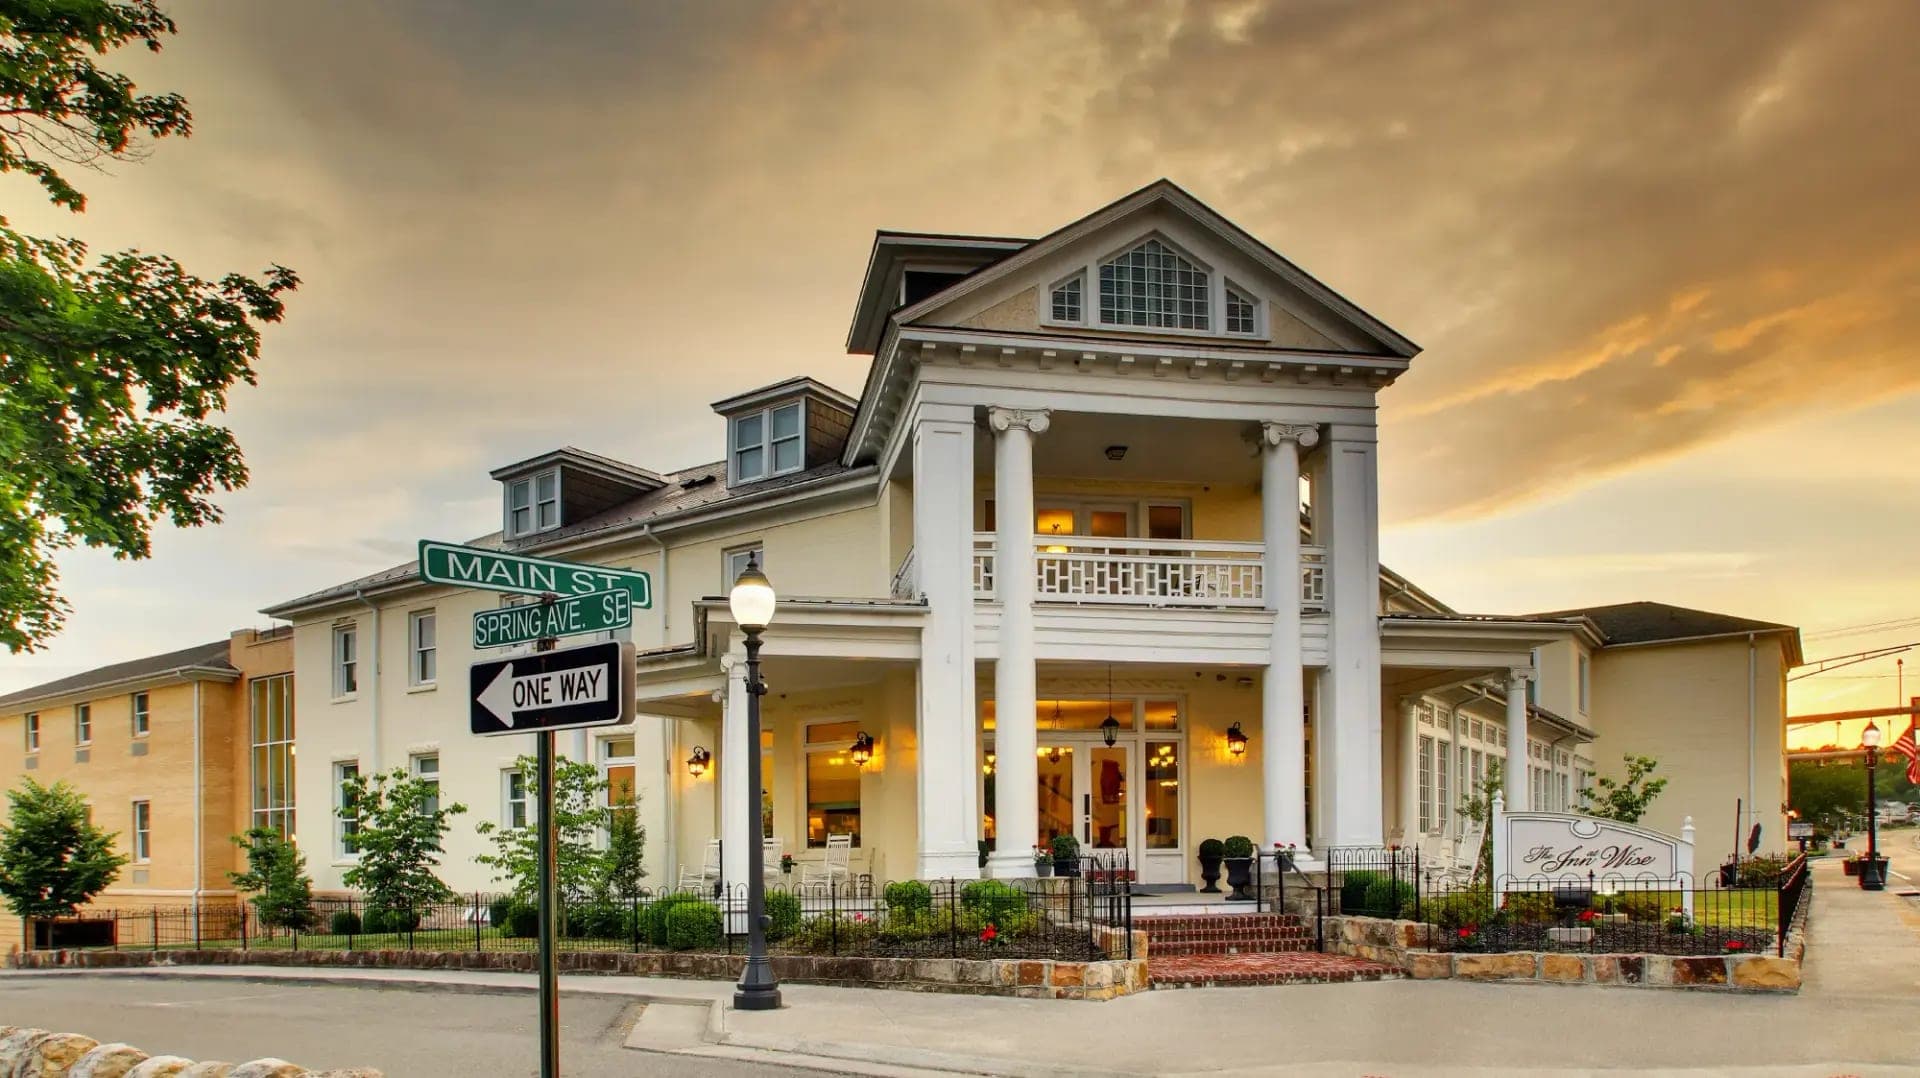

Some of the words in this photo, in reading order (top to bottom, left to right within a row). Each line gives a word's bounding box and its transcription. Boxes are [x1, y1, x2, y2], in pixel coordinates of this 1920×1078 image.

[447, 552, 556, 591] MAIN
[571, 571, 621, 594] ST
[475, 607, 541, 644] SPRING
[546, 600, 586, 635] AVE.
[602, 592, 627, 624] SE
[513, 676, 552, 708] ONE
[560, 668, 602, 702] WAY
[1523, 845, 1553, 863] The
[1540, 845, 1596, 873] Inn
[1600, 845, 1656, 868] Wise
